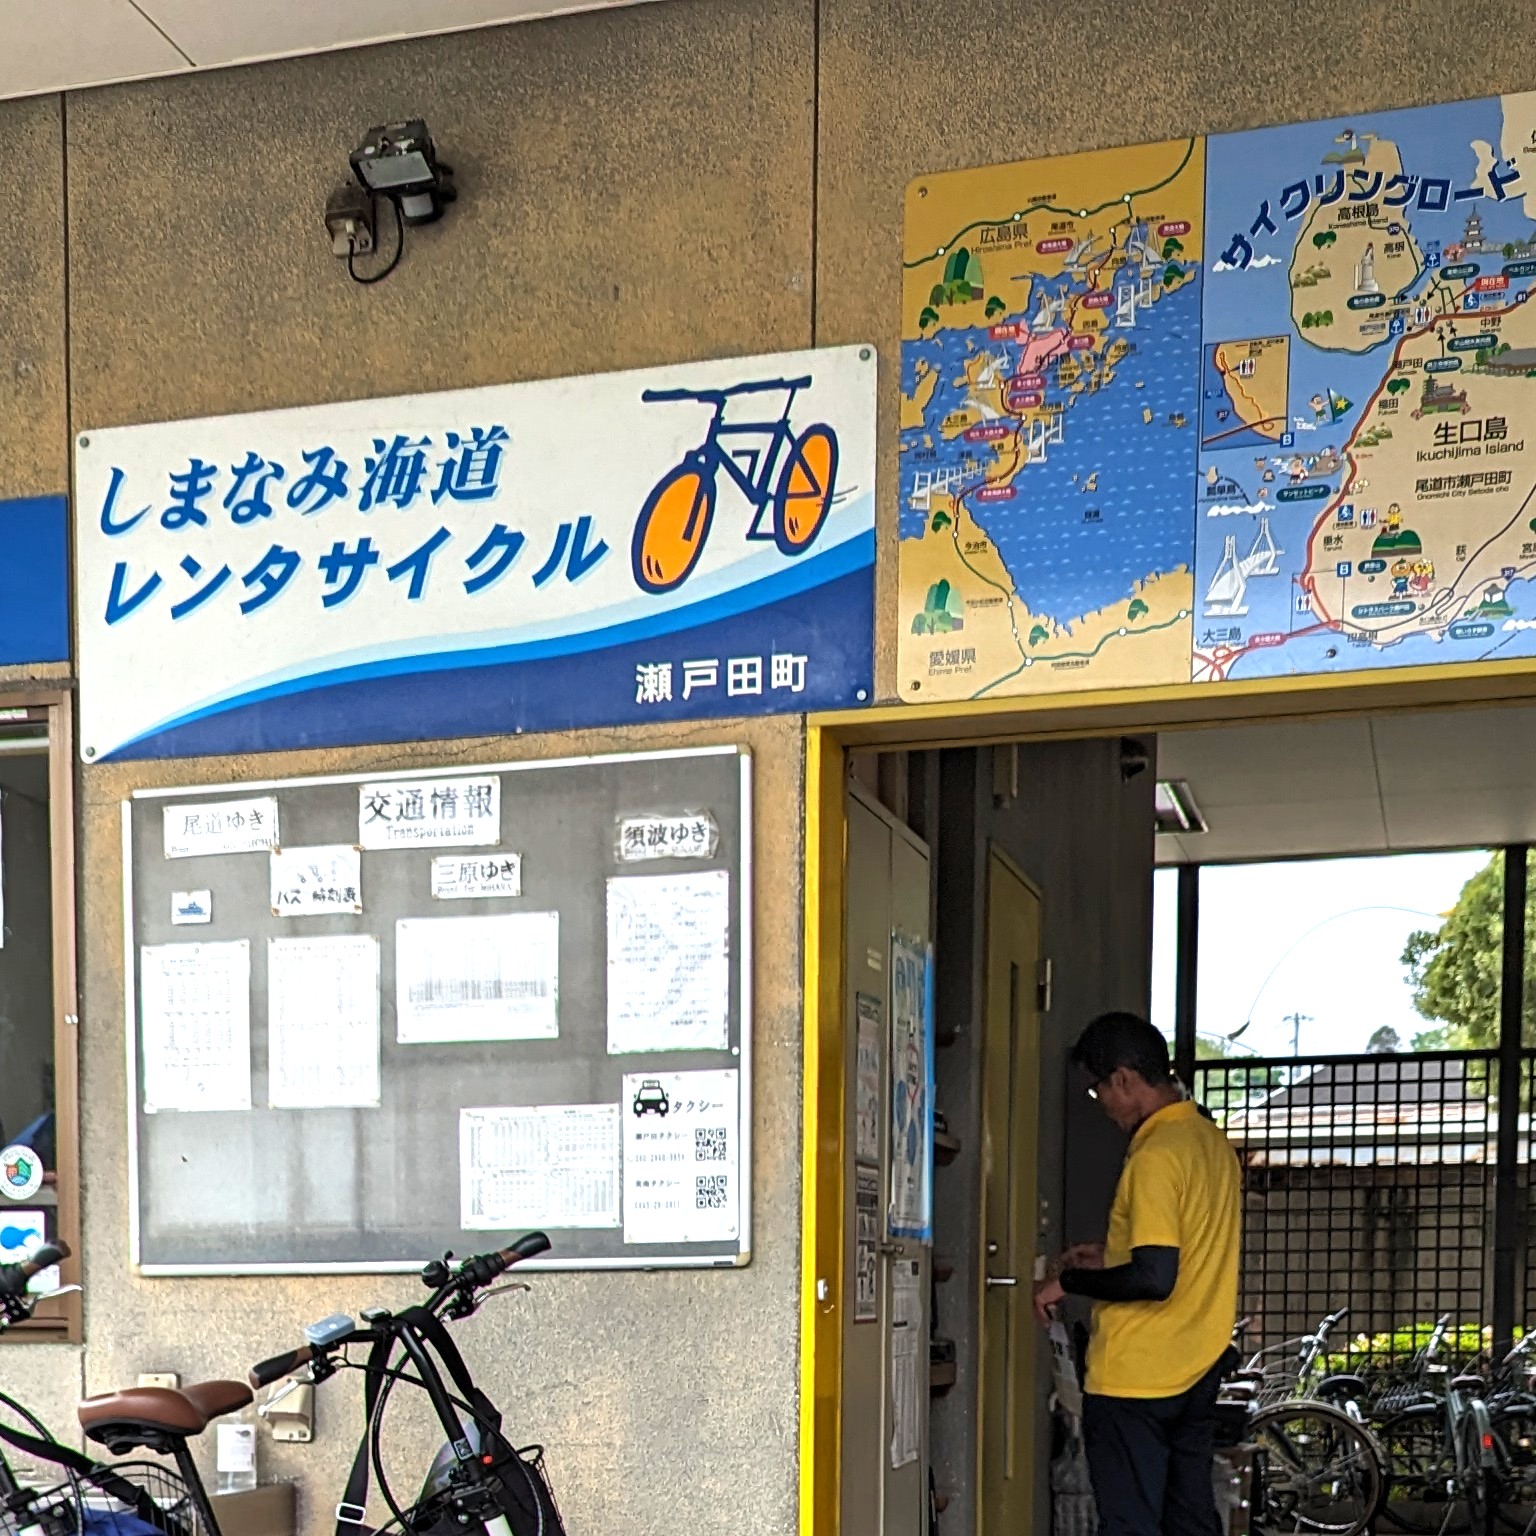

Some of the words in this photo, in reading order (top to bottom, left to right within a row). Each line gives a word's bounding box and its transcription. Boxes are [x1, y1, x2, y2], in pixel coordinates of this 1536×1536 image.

[1220, 157, 1522, 271] サイクリングロード
[979, 222, 1029, 245] 広島県
[1432, 416, 1509, 447] 生口島
[1416, 446, 1482, 463] Ikuchijima
[1484, 440, 1525, 456] Island
[97, 424, 512, 537] しまなみ海道
[1415, 470, 1513, 494] 尾道市瀬戸田町
[103, 514, 611, 627] レンタサイクル
[1203, 626, 1242, 643] 大三島
[929, 648, 977, 667] 愛媛県
[635, 655, 809, 705] 瀬戸田町
[364, 784, 495, 825] 交通情報
[183, 808, 264, 836] 尾道ゆき
[625, 821, 707, 848] 須波ゆき
[437, 859, 516, 884] 三原ゆき
[672, 1099, 724, 1114] タクシー
